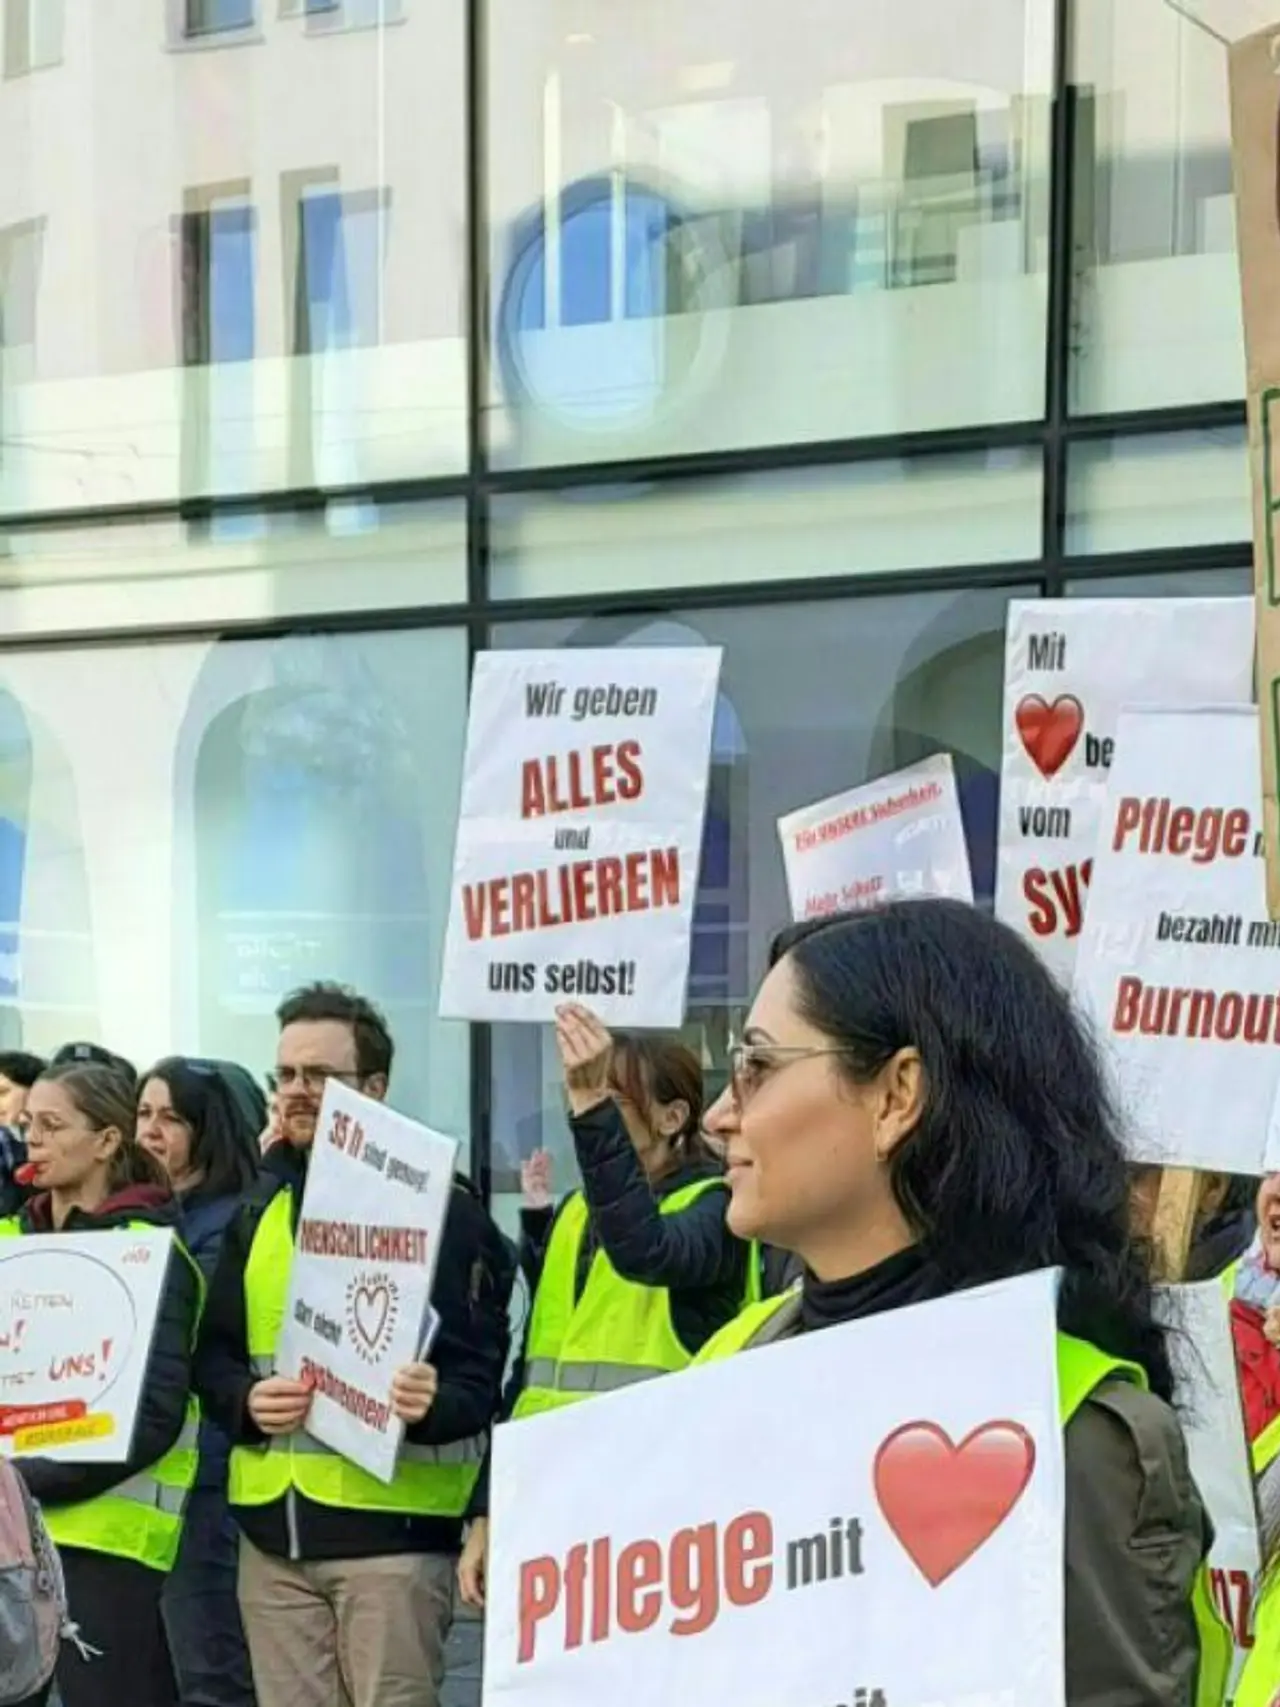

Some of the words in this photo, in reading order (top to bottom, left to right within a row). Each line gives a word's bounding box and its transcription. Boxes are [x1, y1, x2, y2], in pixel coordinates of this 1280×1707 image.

[1027, 633, 1067, 672] Mit
[525, 682, 567, 718] Wir
[571, 682, 657, 721] geben
[521, 740, 643, 820] ALLES
[553, 826, 591, 851] und
[1019, 805, 1072, 838] vom
[1113, 797, 1250, 863] Pflege
[462, 846, 681, 941] VERLIEREN
[1155, 911, 1243, 946] bezahlt
[488, 961, 536, 993] uns
[543, 960, 636, 996] selbst!
[516, 1509, 775, 1664] Pflege
[785, 1515, 866, 1591] mit
